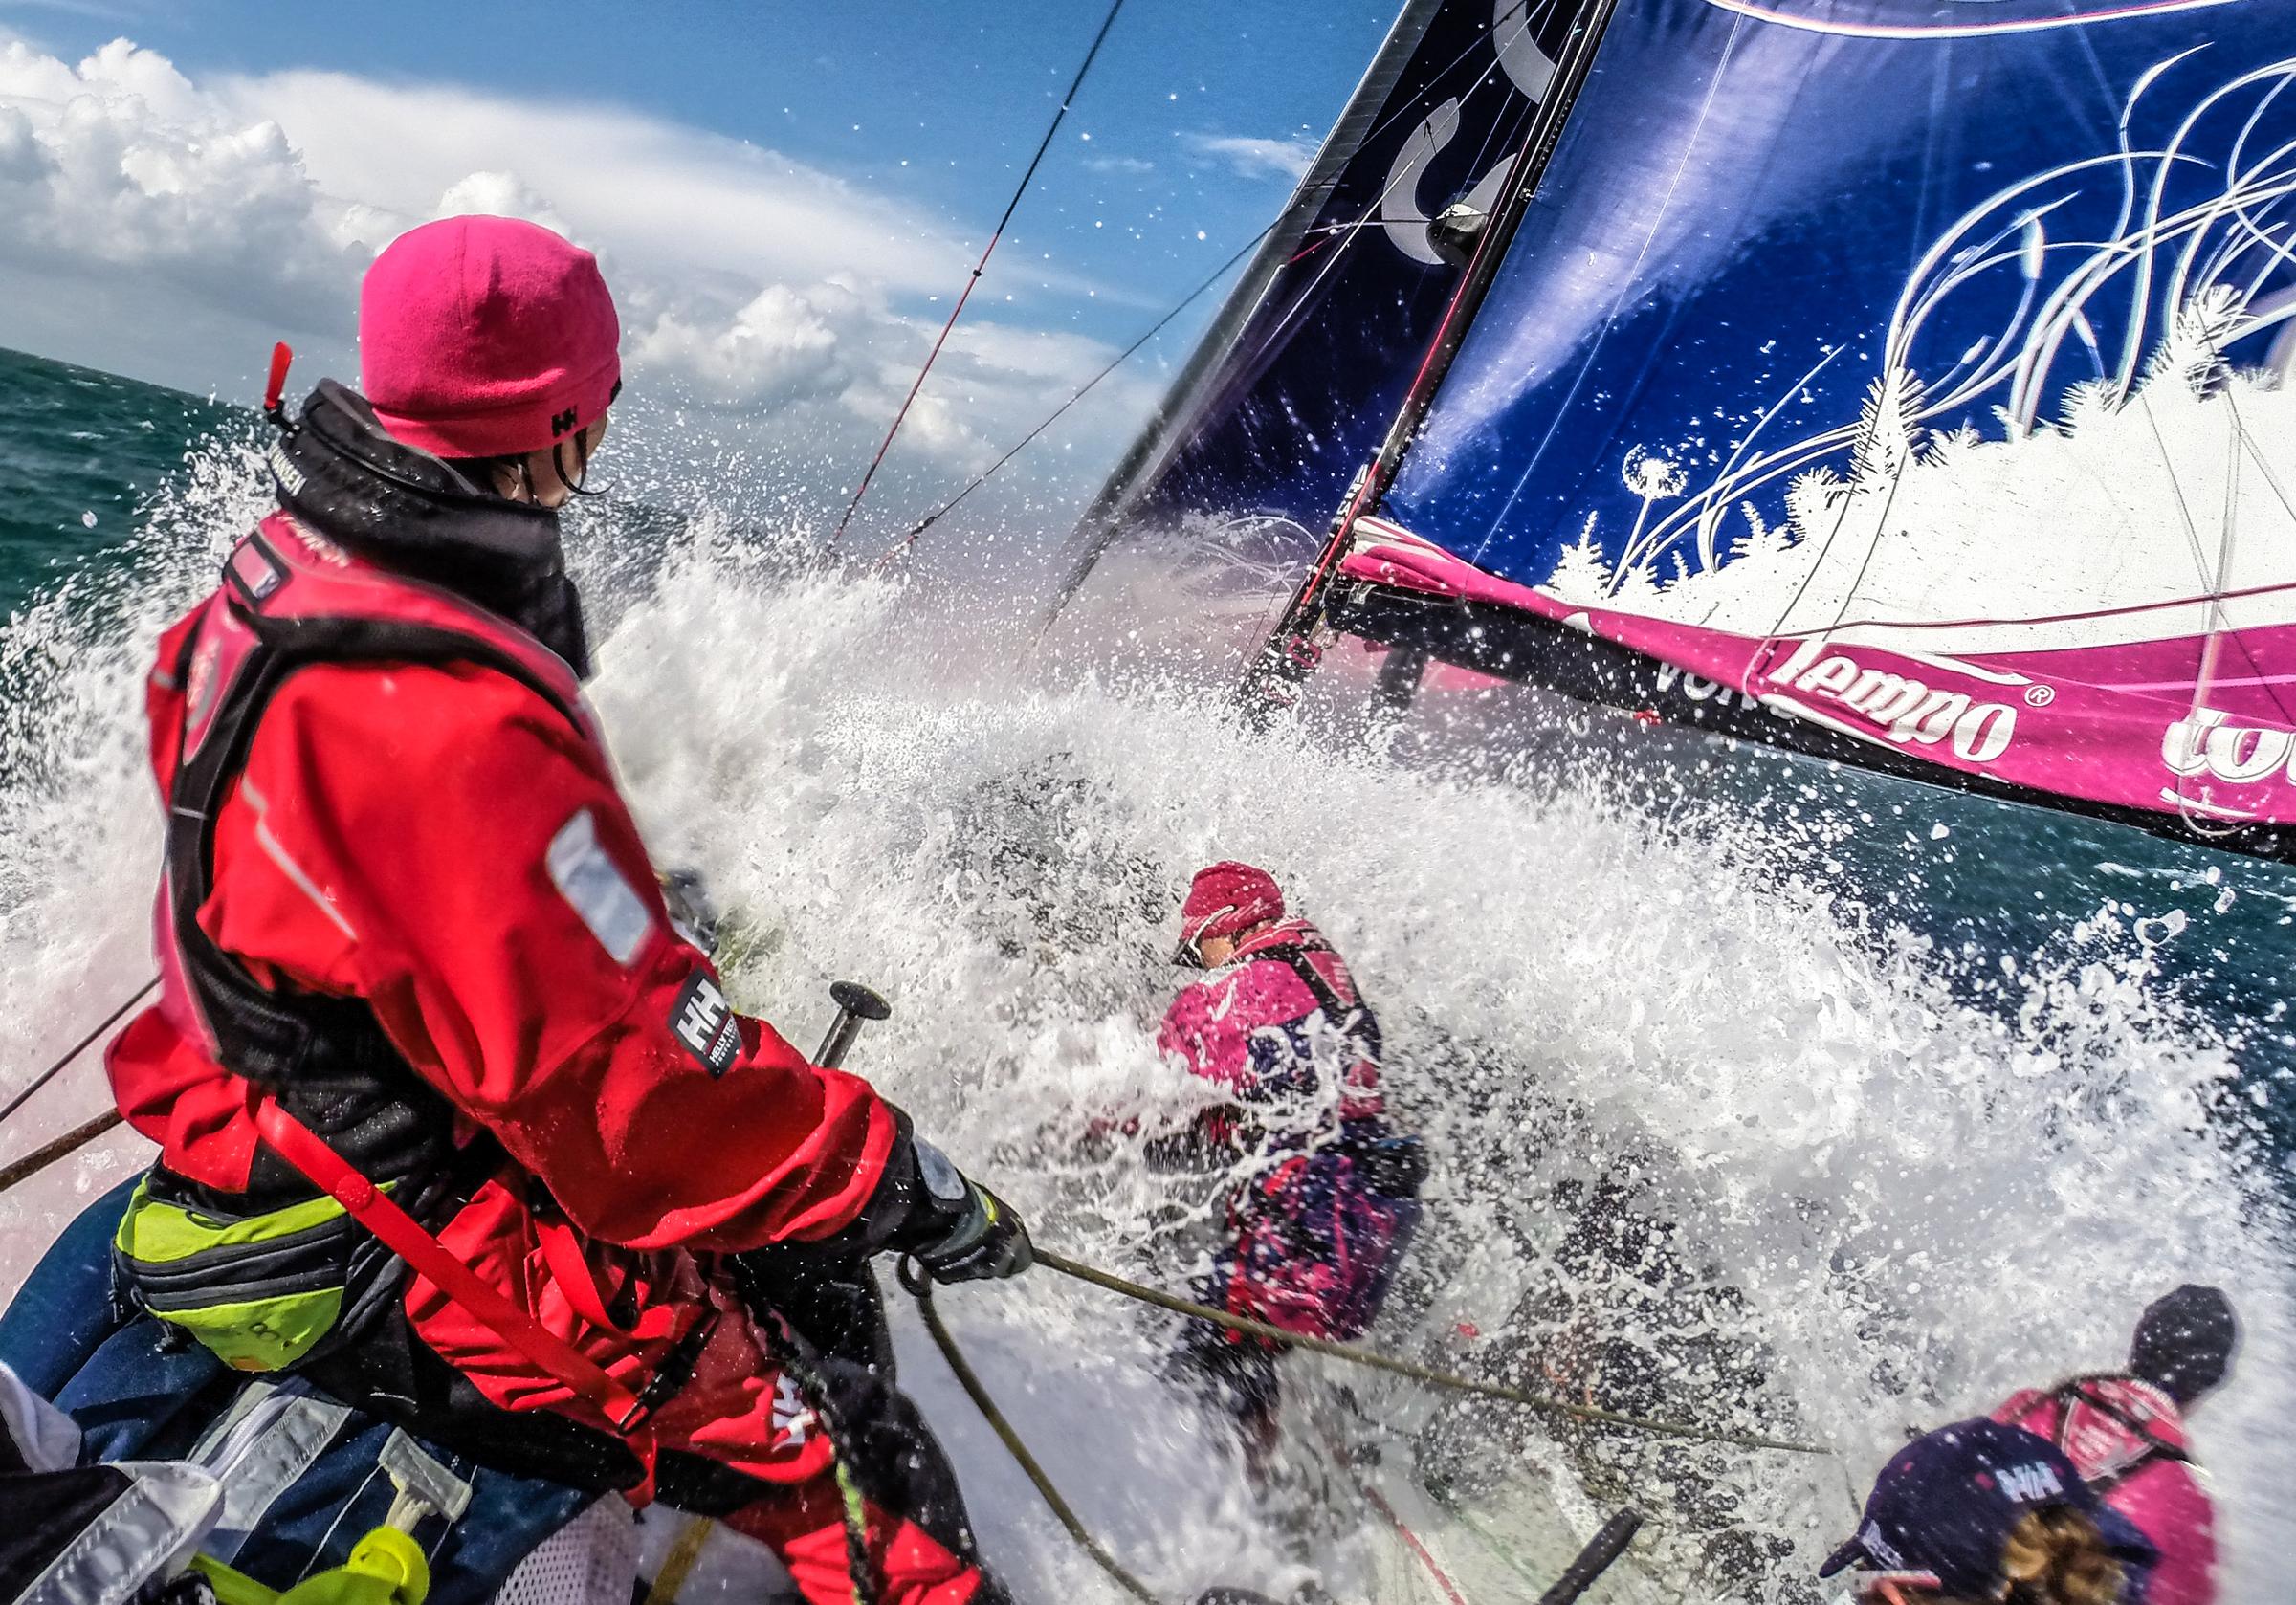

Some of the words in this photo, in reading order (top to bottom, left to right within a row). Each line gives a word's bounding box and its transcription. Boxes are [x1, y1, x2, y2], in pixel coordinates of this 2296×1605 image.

[676, 978, 728, 1051] HH
[709, 1035, 727, 1063] HELLY
[1995, 1461, 2064, 1503] HH
